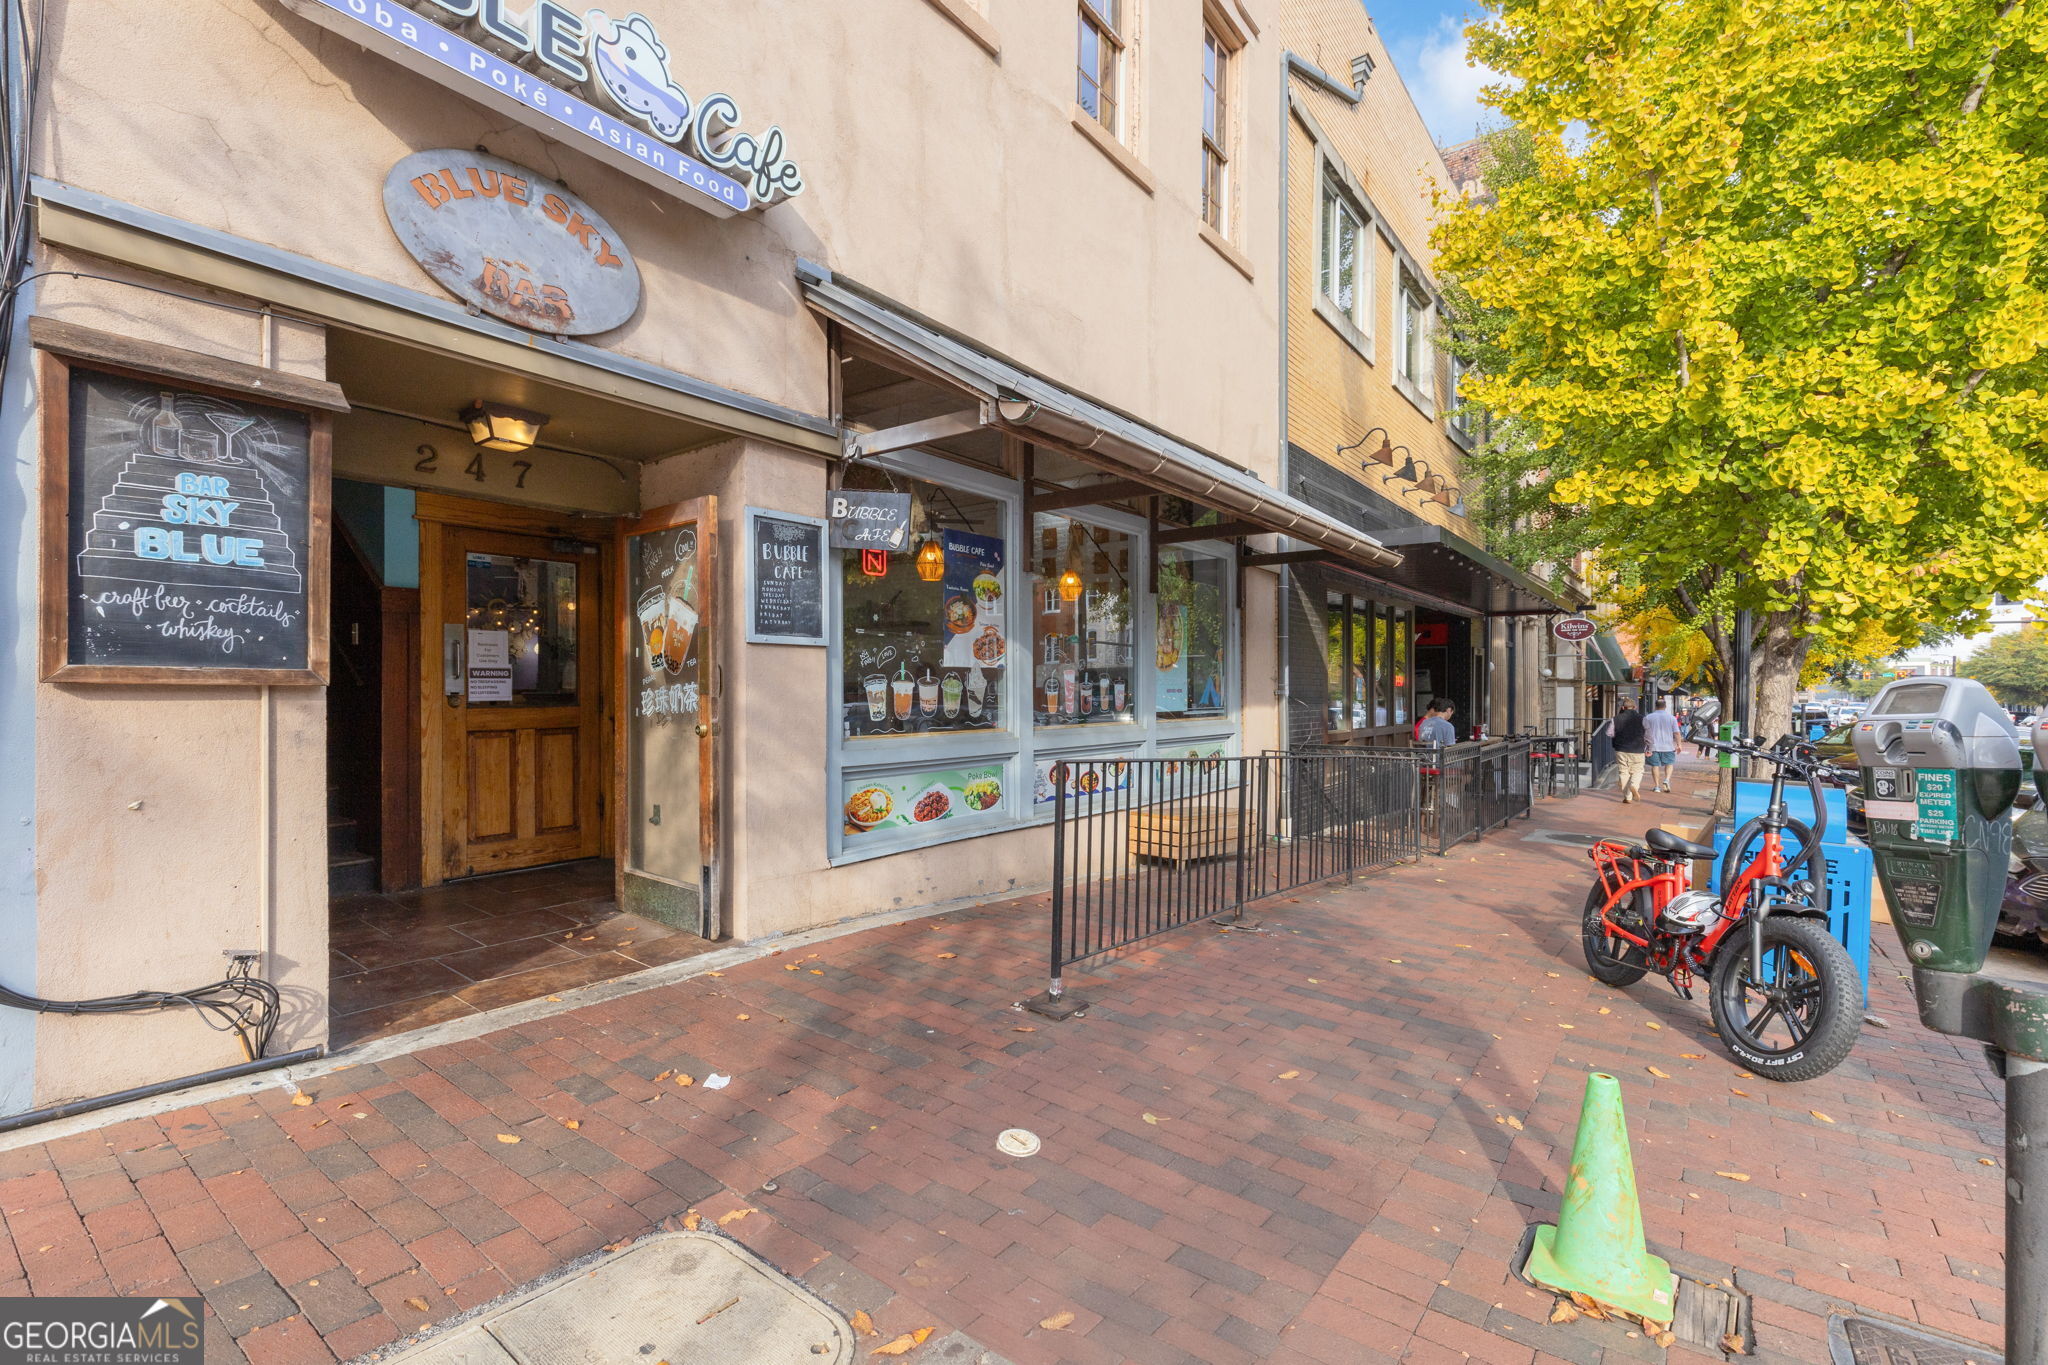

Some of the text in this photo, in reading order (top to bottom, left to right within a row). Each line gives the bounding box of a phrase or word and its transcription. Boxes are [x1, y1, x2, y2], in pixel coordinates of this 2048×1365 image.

[469, 52, 548, 108] Poké
[588, 115, 665, 168] Asian
[678, 160, 735, 202] Food
[694, 94, 804, 201] Cafe
[409, 167, 624, 268] BLUE SKY
[483, 261, 576, 320] BAR
[174, 473, 230, 498] BAR
[160, 494, 240, 527] SKY
[832, 497, 898, 521] BUBBLE
[134, 527, 265, 567] BLUE
[762, 542, 808, 563] BUBBLE
[948, 542, 985, 557] BUBBLE CAFE
[774, 565, 803, 580] CAFE
[91, 584, 296, 628] craft beer cocktails
[156, 614, 245, 654] whiskey
[641, 681, 699, 717] 珍珠奶茶
[983, 771, 998, 779] Bowl
[1918, 773, 1952, 782] FINES
[1919, 791, 1952, 799] EXPIRED
[1920, 798, 1952, 806] METER
[1919, 817, 1954, 826] PARKING
[1927, 809, 1944, 817] $25
[1786, 1051, 1804, 1065] CST
